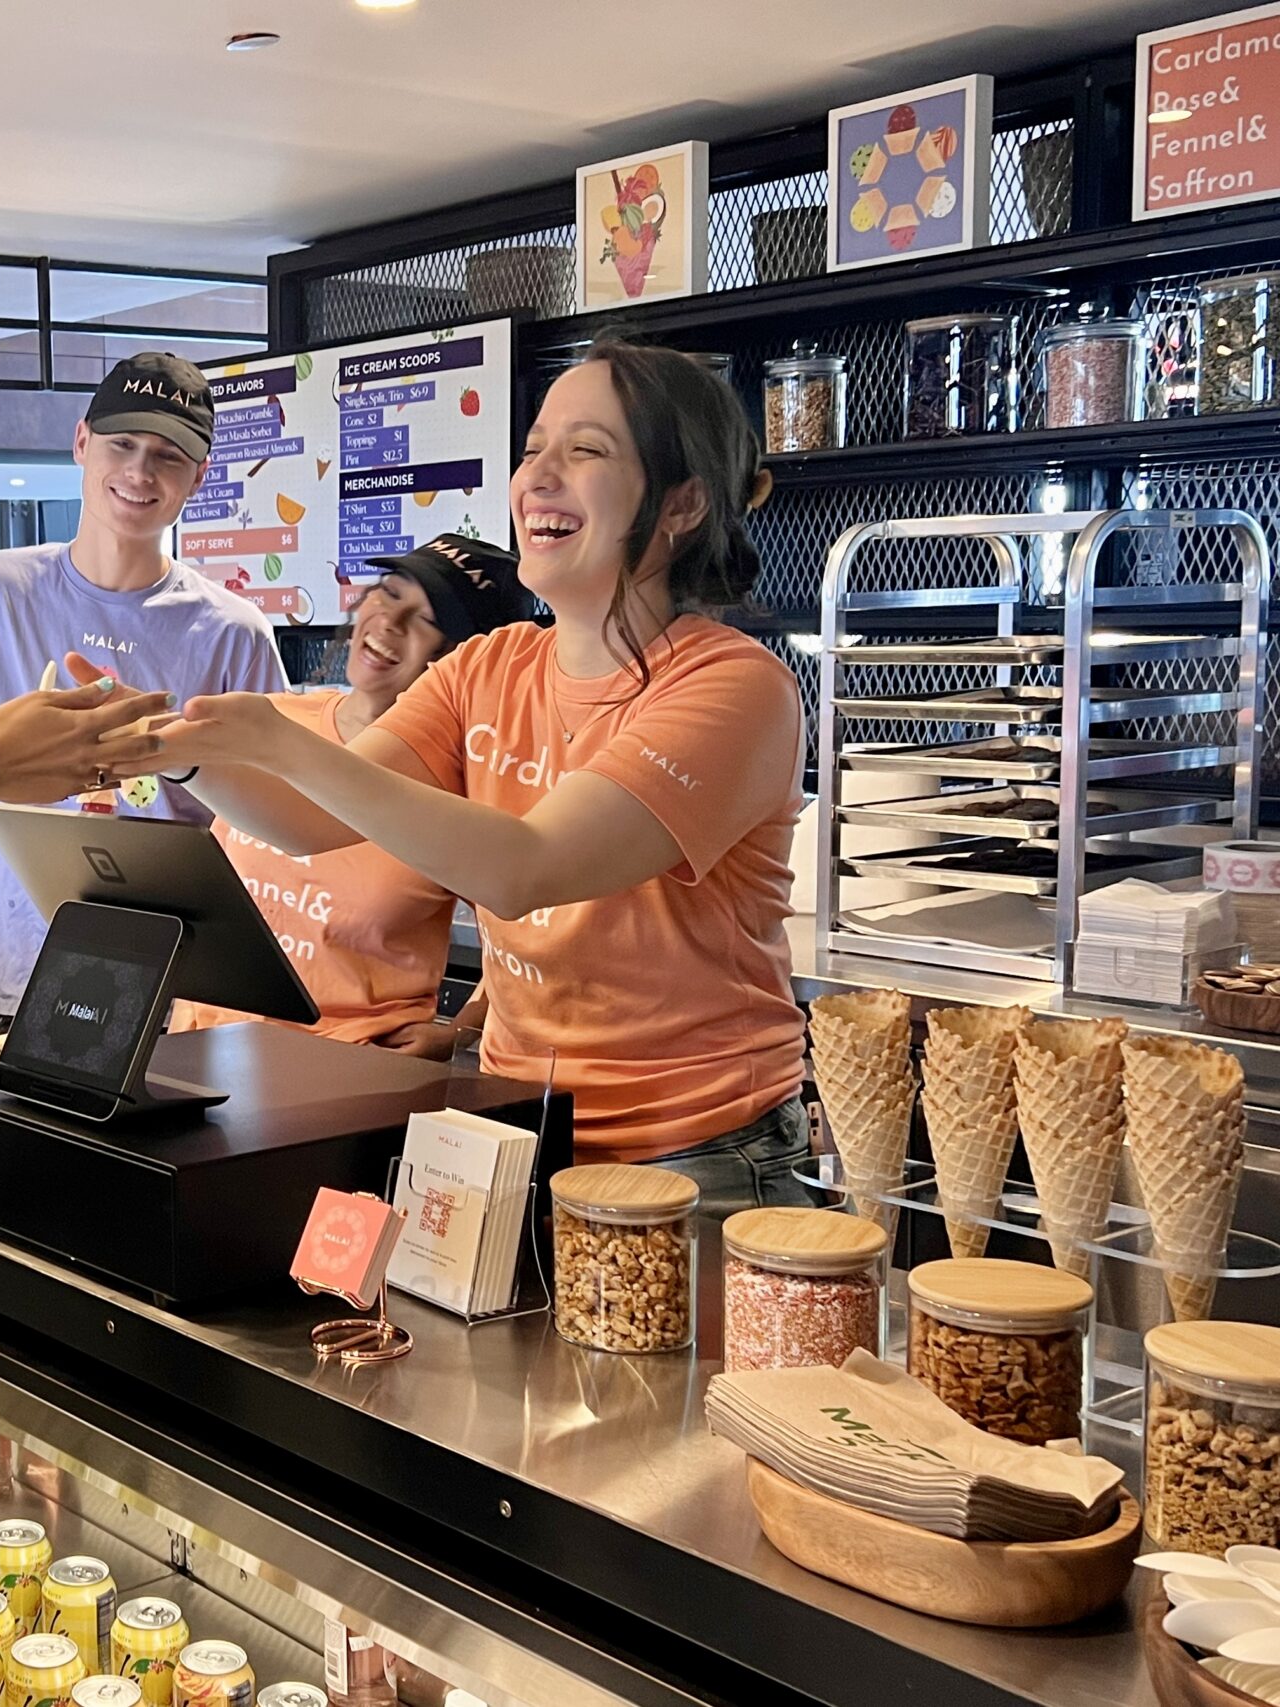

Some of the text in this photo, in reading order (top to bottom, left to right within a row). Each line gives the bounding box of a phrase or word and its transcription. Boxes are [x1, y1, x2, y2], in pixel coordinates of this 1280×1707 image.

[1148, 167, 1254, 202] Saffron
[344, 351, 441, 377] ICE CREAM SCOOPS
[123, 378, 192, 408] MALAI
[226, 378, 265, 395] FLAVORS
[388, 389, 404, 401] Trio
[344, 413, 377, 427] Cone $2
[251, 425, 272, 439] Sorbet
[345, 430, 403, 449] Toppings $1
[211, 440, 299, 462] Cinnamon Roasted Almonds
[345, 454, 360, 466] Pint
[206, 469, 221, 480] Chai
[344, 473, 415, 491] MERCHANDISE
[213, 487, 235, 499] Cream
[186, 507, 221, 520] Black Forest
[344, 523, 360, 535] Tote
[360, 522, 375, 536] Bag
[185, 534, 293, 551] SOFT SERVE $6
[344, 540, 408, 554] Chai Masala $12
[344, 562, 357, 573] Tea
[281, 594, 293, 607] $6
[82, 632, 135, 655] MALAI
[639, 746, 698, 791] MALAI
[424, 1163, 465, 1185] Enter to Win
